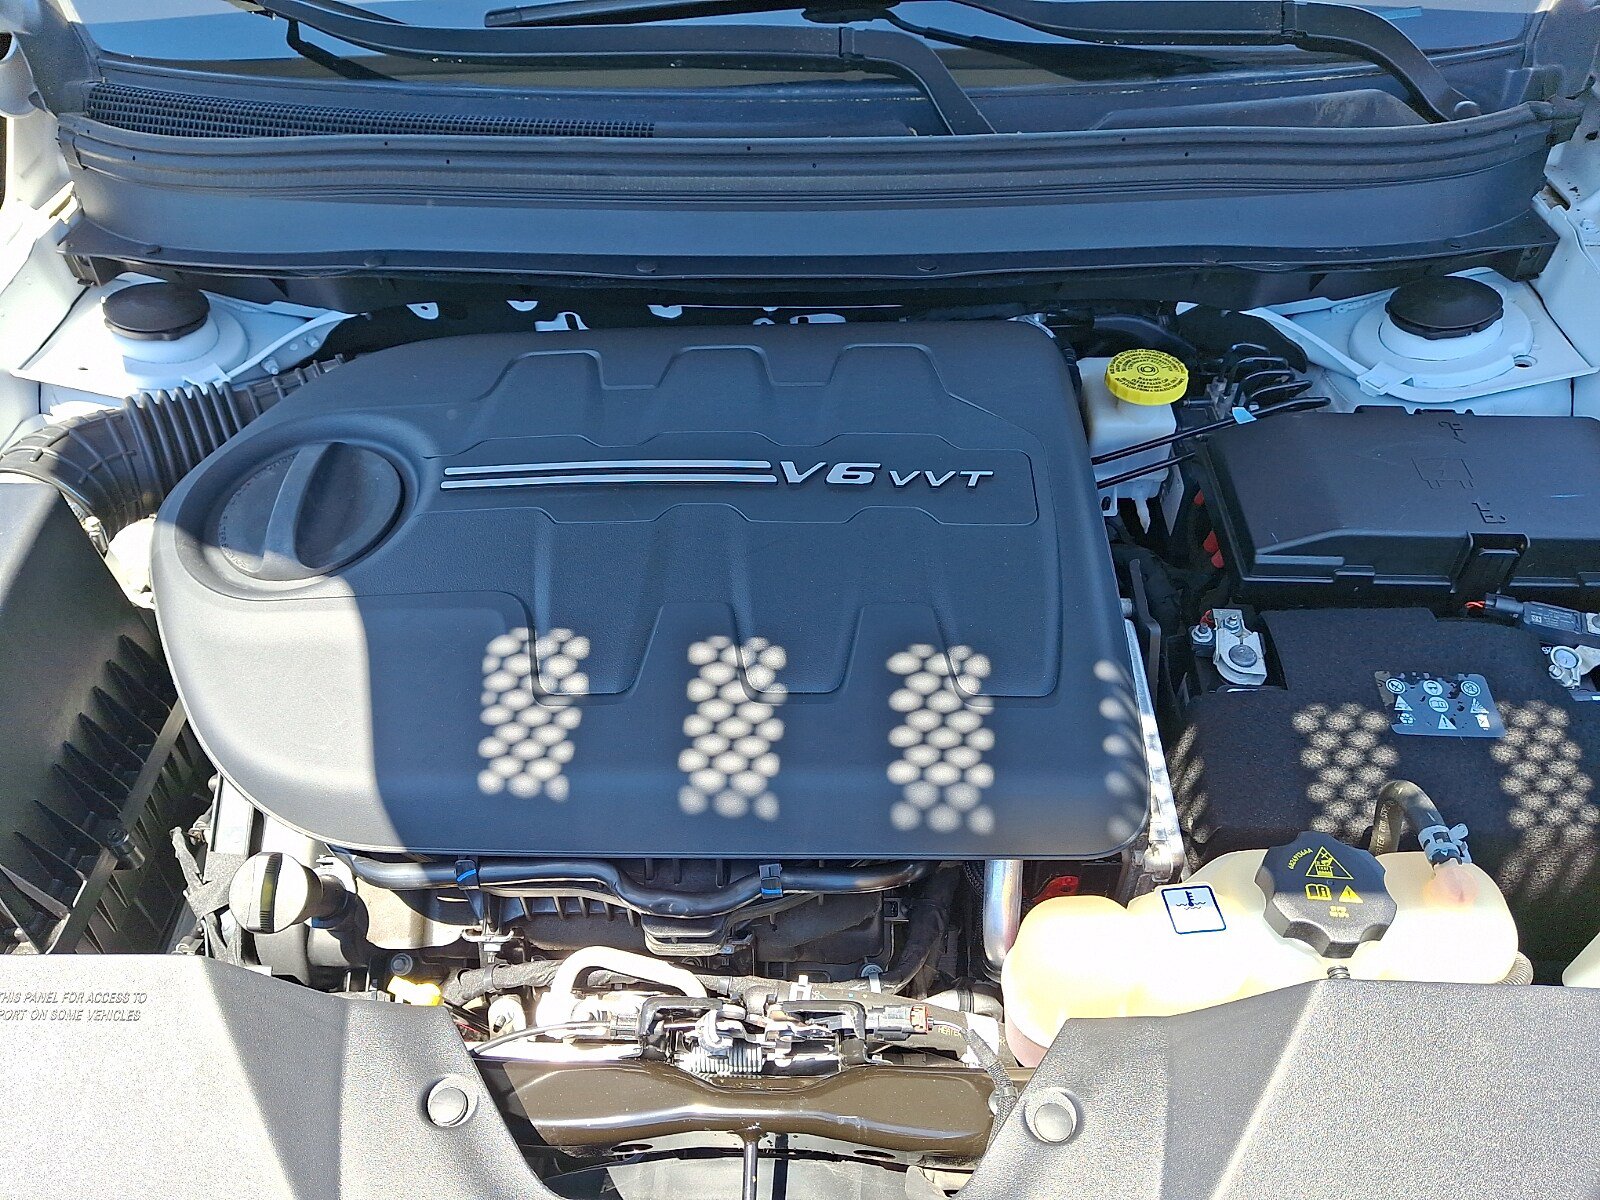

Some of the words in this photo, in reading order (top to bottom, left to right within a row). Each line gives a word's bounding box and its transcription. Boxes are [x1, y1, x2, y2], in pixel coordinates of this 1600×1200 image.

[779, 460, 881, 485] V6
[888, 470, 995, 488] VVT
[23, 991, 59, 1003] PANEL
[61, 991, 85, 1003] FOR
[86, 991, 131, 1003] ACCESS
[133, 992, 148, 1004] TO
[30, 1009, 49, 1021] ON
[50, 1009, 84, 1021] SOME
[87, 1009, 141, 1021] VEHICLES
